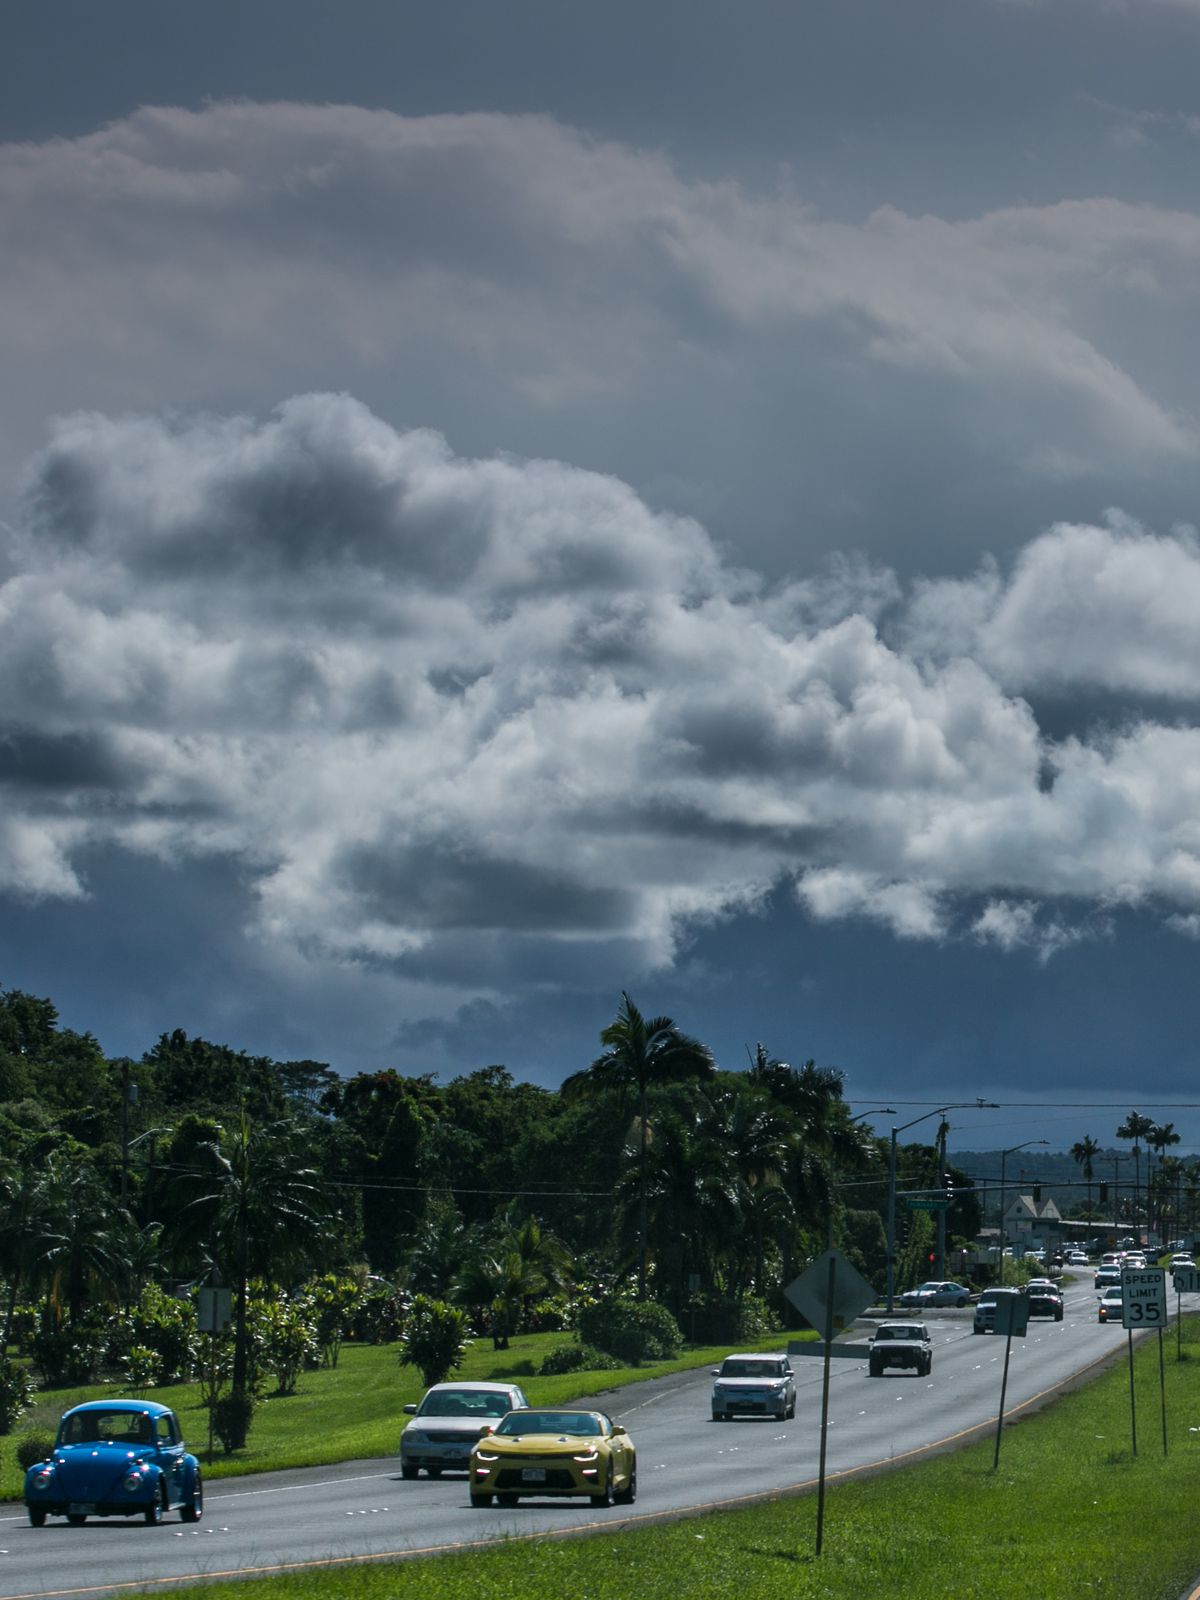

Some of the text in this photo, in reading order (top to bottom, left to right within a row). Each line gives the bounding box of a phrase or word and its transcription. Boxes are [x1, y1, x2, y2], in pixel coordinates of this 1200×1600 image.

[1125, 1274, 1162, 1285] SPEED
[1129, 1288, 1158, 1298] LIMIT
[1130, 1302, 1161, 1322] 35
